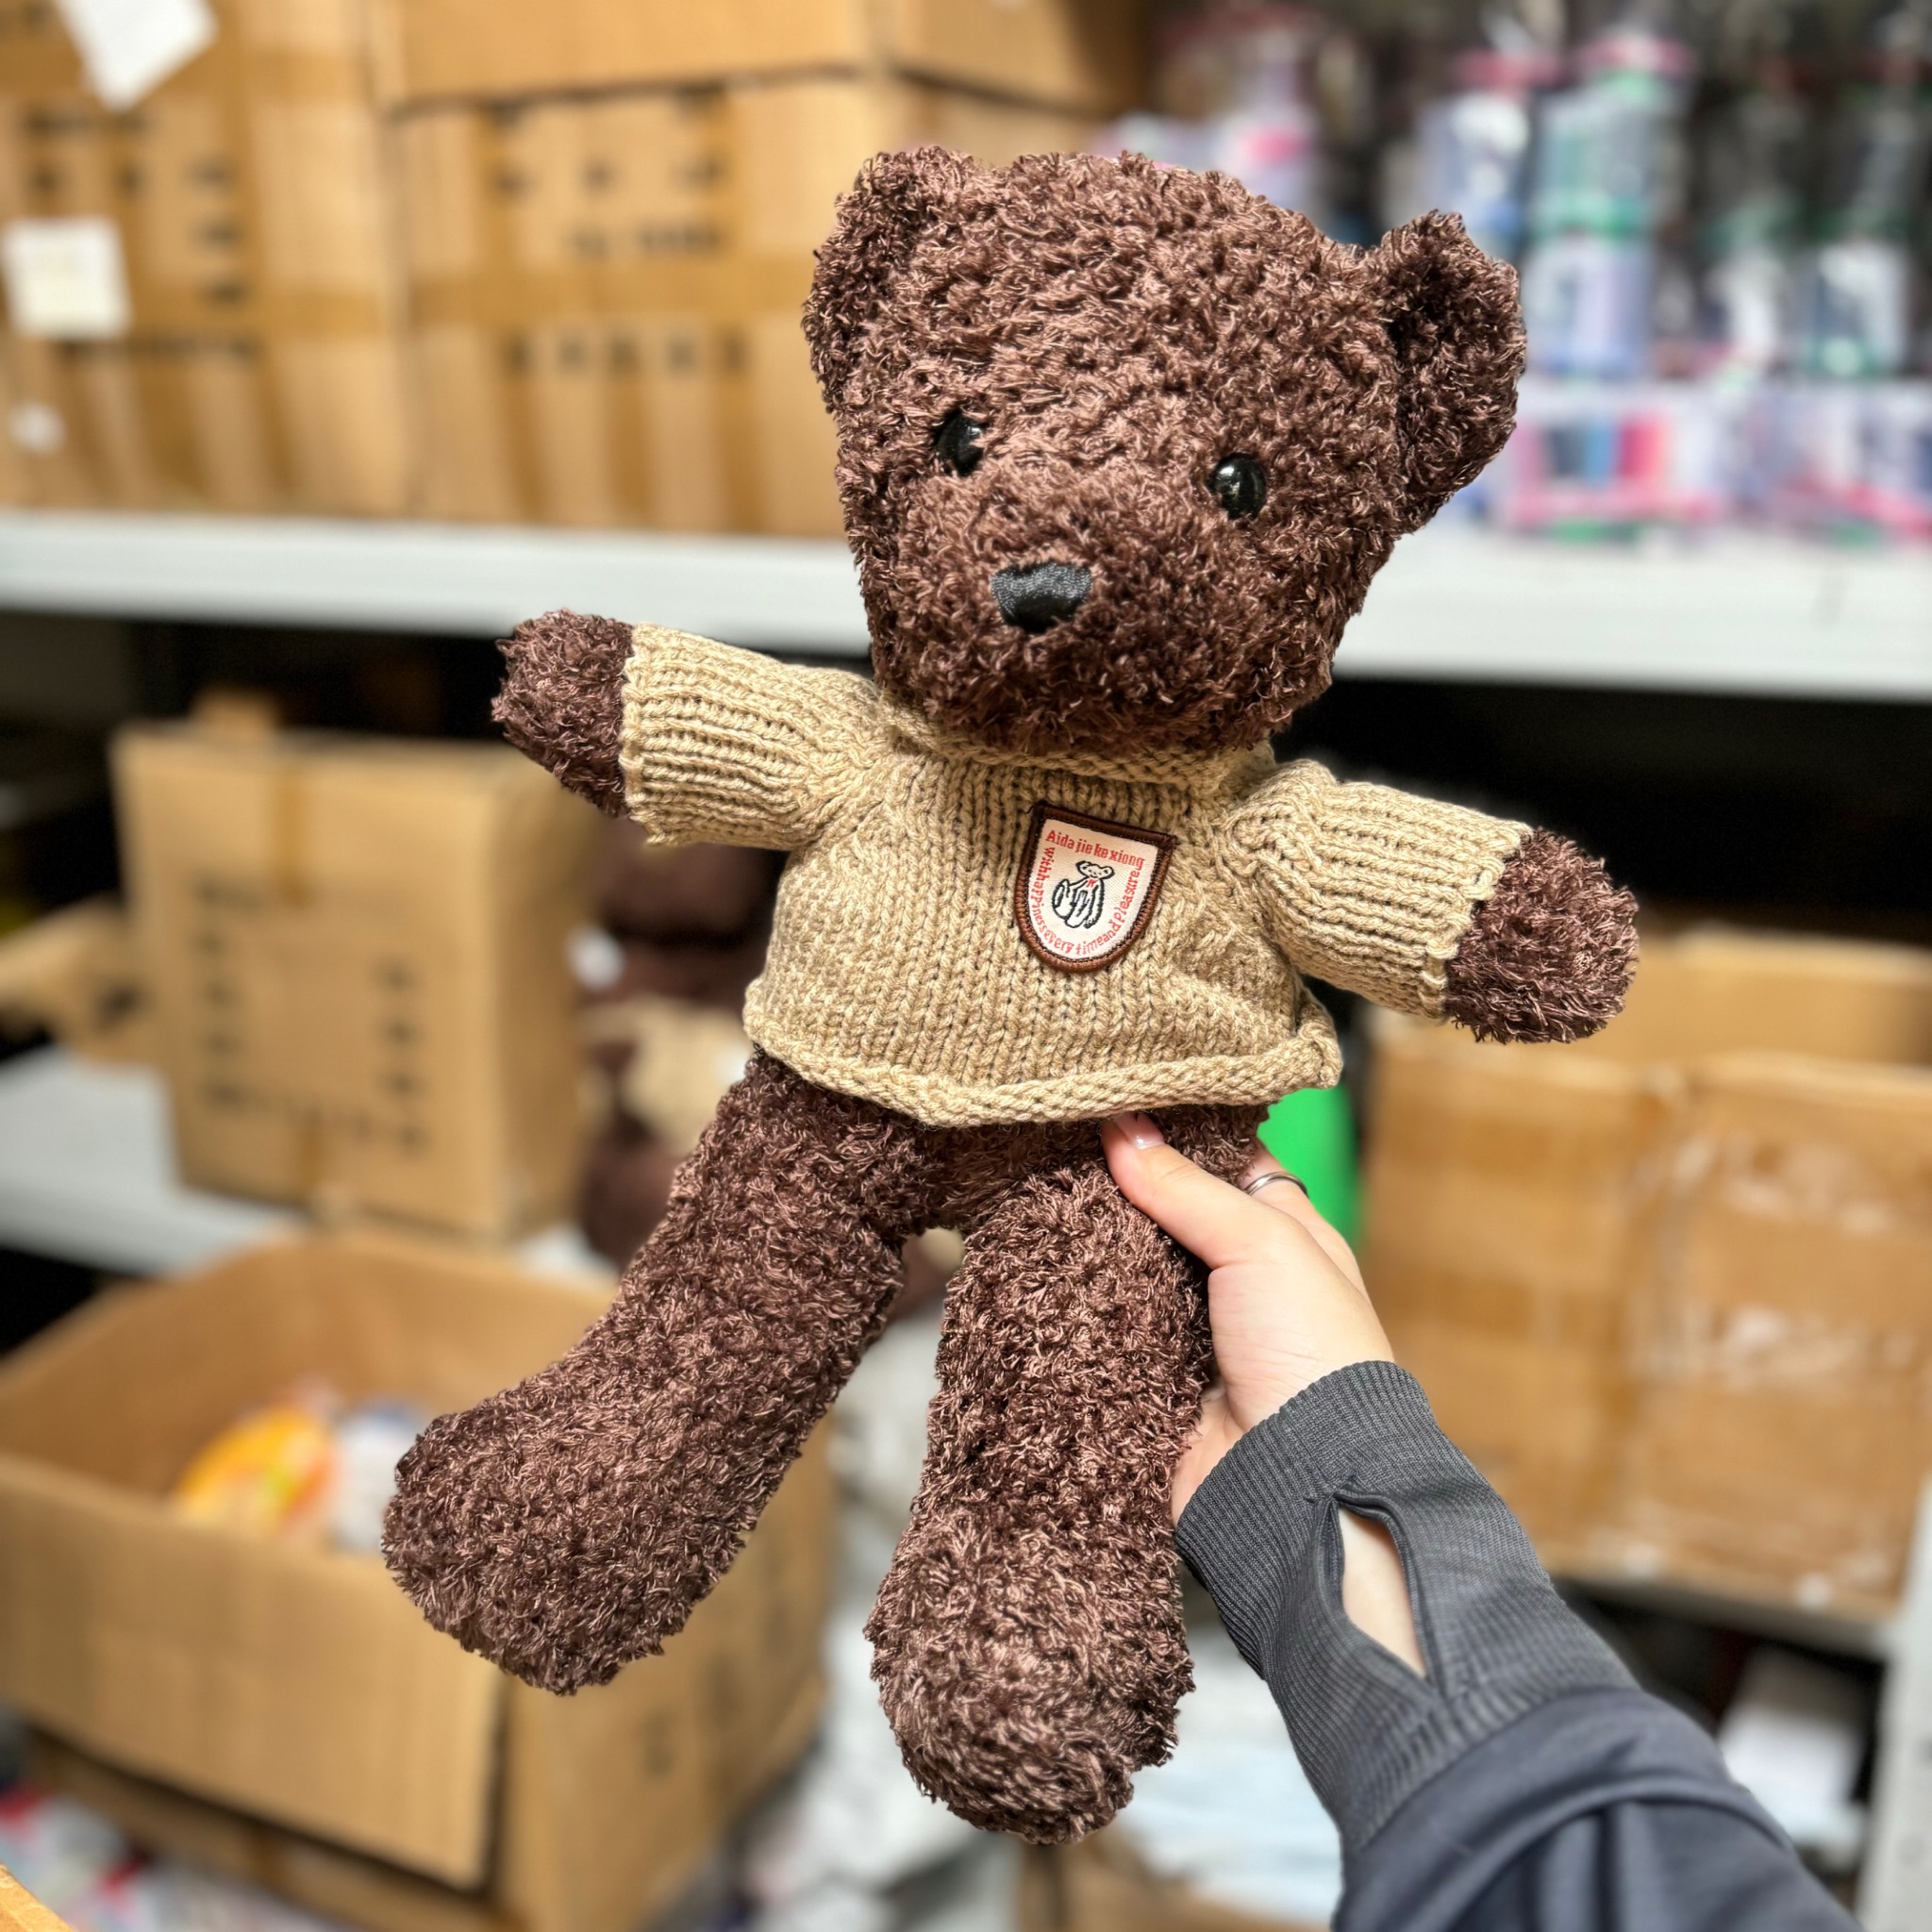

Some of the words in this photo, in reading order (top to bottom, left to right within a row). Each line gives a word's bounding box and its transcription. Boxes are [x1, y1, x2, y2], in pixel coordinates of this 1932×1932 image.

[1046, 830, 1074, 849] Aida
[1075, 839, 1092, 853] jie
[1094, 843, 1108, 858] ke
[1109, 850, 1145, 871] xiong
